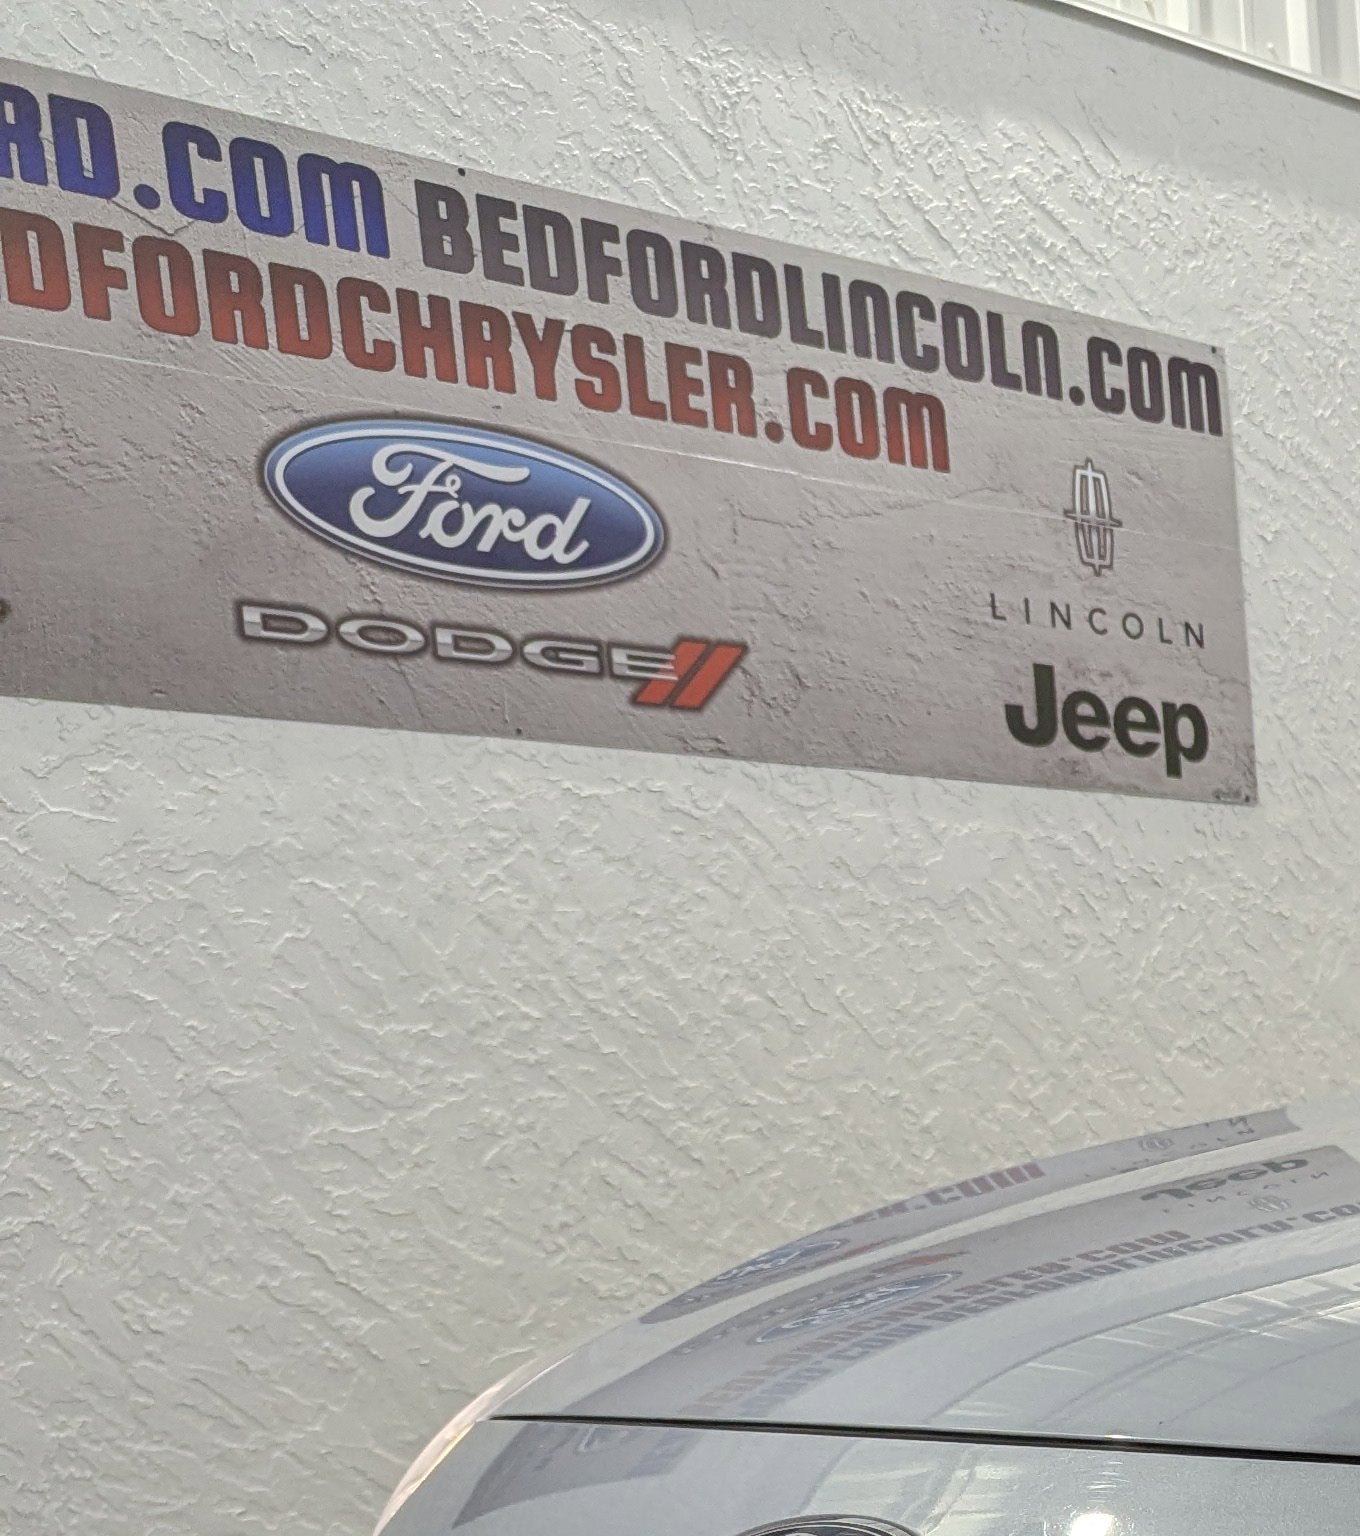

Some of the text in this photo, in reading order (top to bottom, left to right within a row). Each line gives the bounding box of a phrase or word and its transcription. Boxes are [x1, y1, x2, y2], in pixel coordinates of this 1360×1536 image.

[414, 178, 1225, 438] BEDFORDLINCOLN.COM
[348, 443, 593, 565] Ford
[240, 604, 680, 682] DODGE
[989, 592, 1205, 649] LINCOLN
[1004, 662, 1210, 779] Jeep
